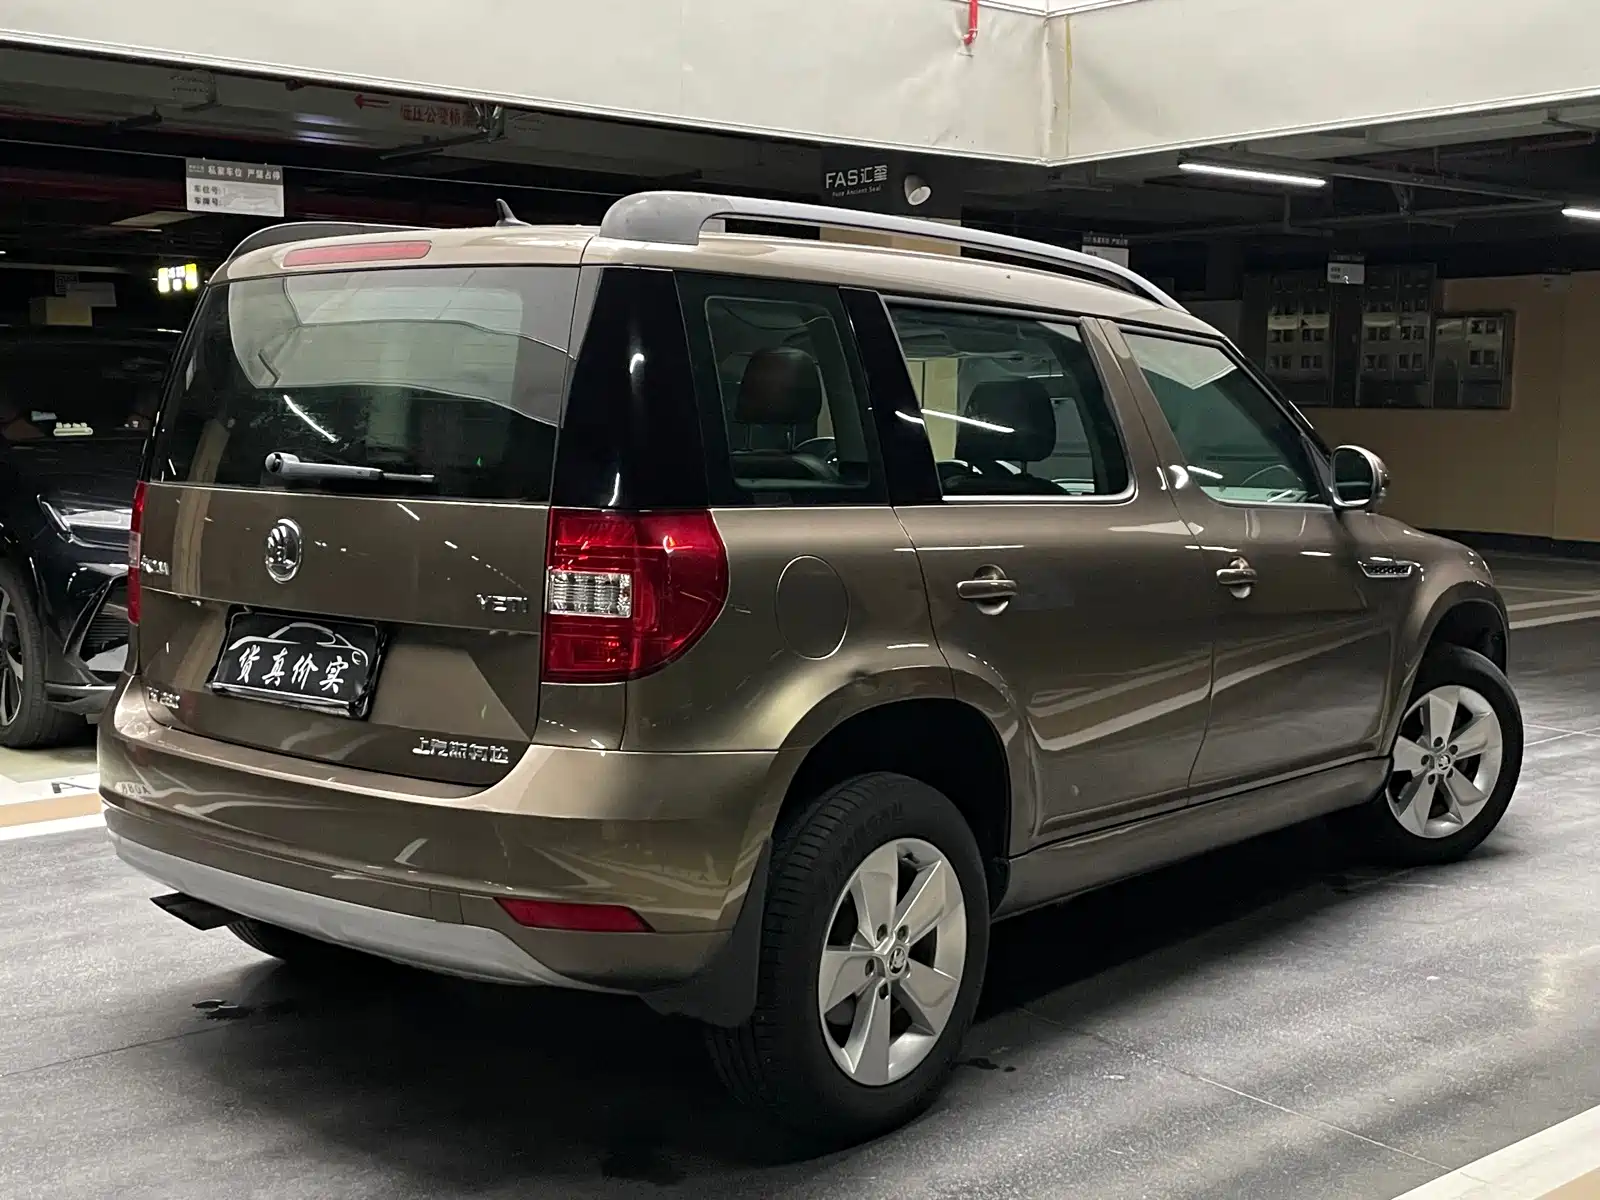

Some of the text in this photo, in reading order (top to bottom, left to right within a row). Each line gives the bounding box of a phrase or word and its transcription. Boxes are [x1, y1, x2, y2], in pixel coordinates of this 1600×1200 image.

[476, 594, 528, 613] YETI
[236, 644, 349, 694] 货真价实
